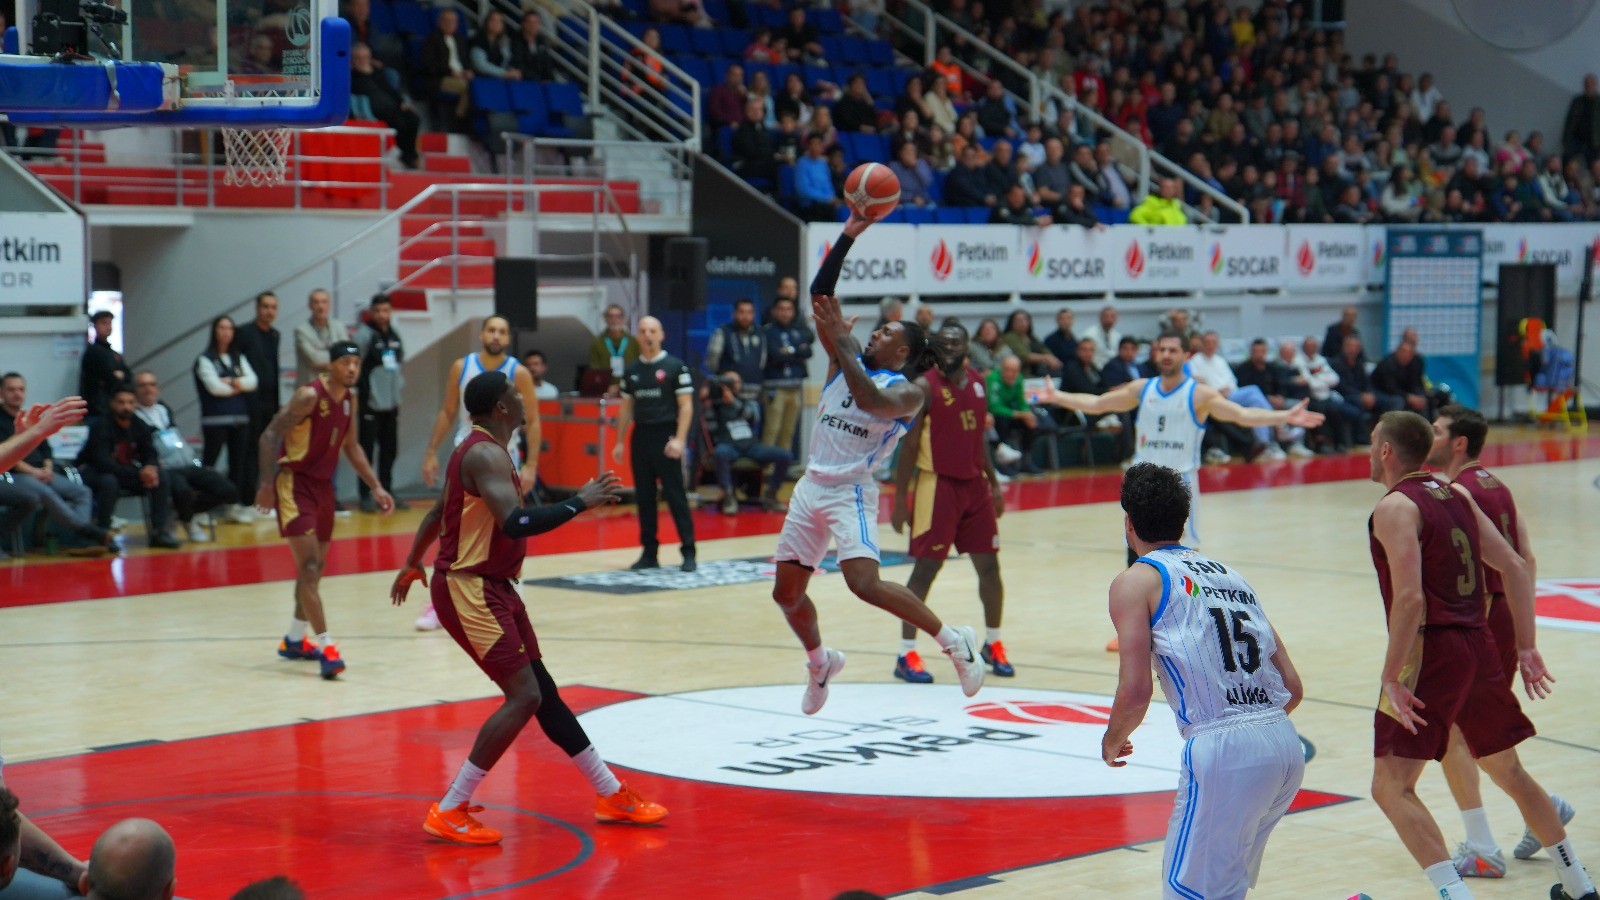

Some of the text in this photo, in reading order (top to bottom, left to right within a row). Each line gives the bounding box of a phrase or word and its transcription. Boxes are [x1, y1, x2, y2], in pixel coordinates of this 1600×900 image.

[0, 236, 60, 262] tkim
[957, 242, 1008, 262] Petkim
[1148, 242, 1193, 261] Petkim
[1318, 240, 1358, 258] Petkim
[842, 258, 906, 281] SOCAR
[1047, 257, 1105, 279] SOCAR
[1227, 255, 1279, 277] SOCAR
[959, 409, 977, 431] 15
[1158, 415, 1166, 432] 9
[1451, 527, 1476, 597] 3
[1208, 607, 1262, 675] 15
[736, 716, 939, 749] SPOR
[718, 727, 1042, 776] Petkim
